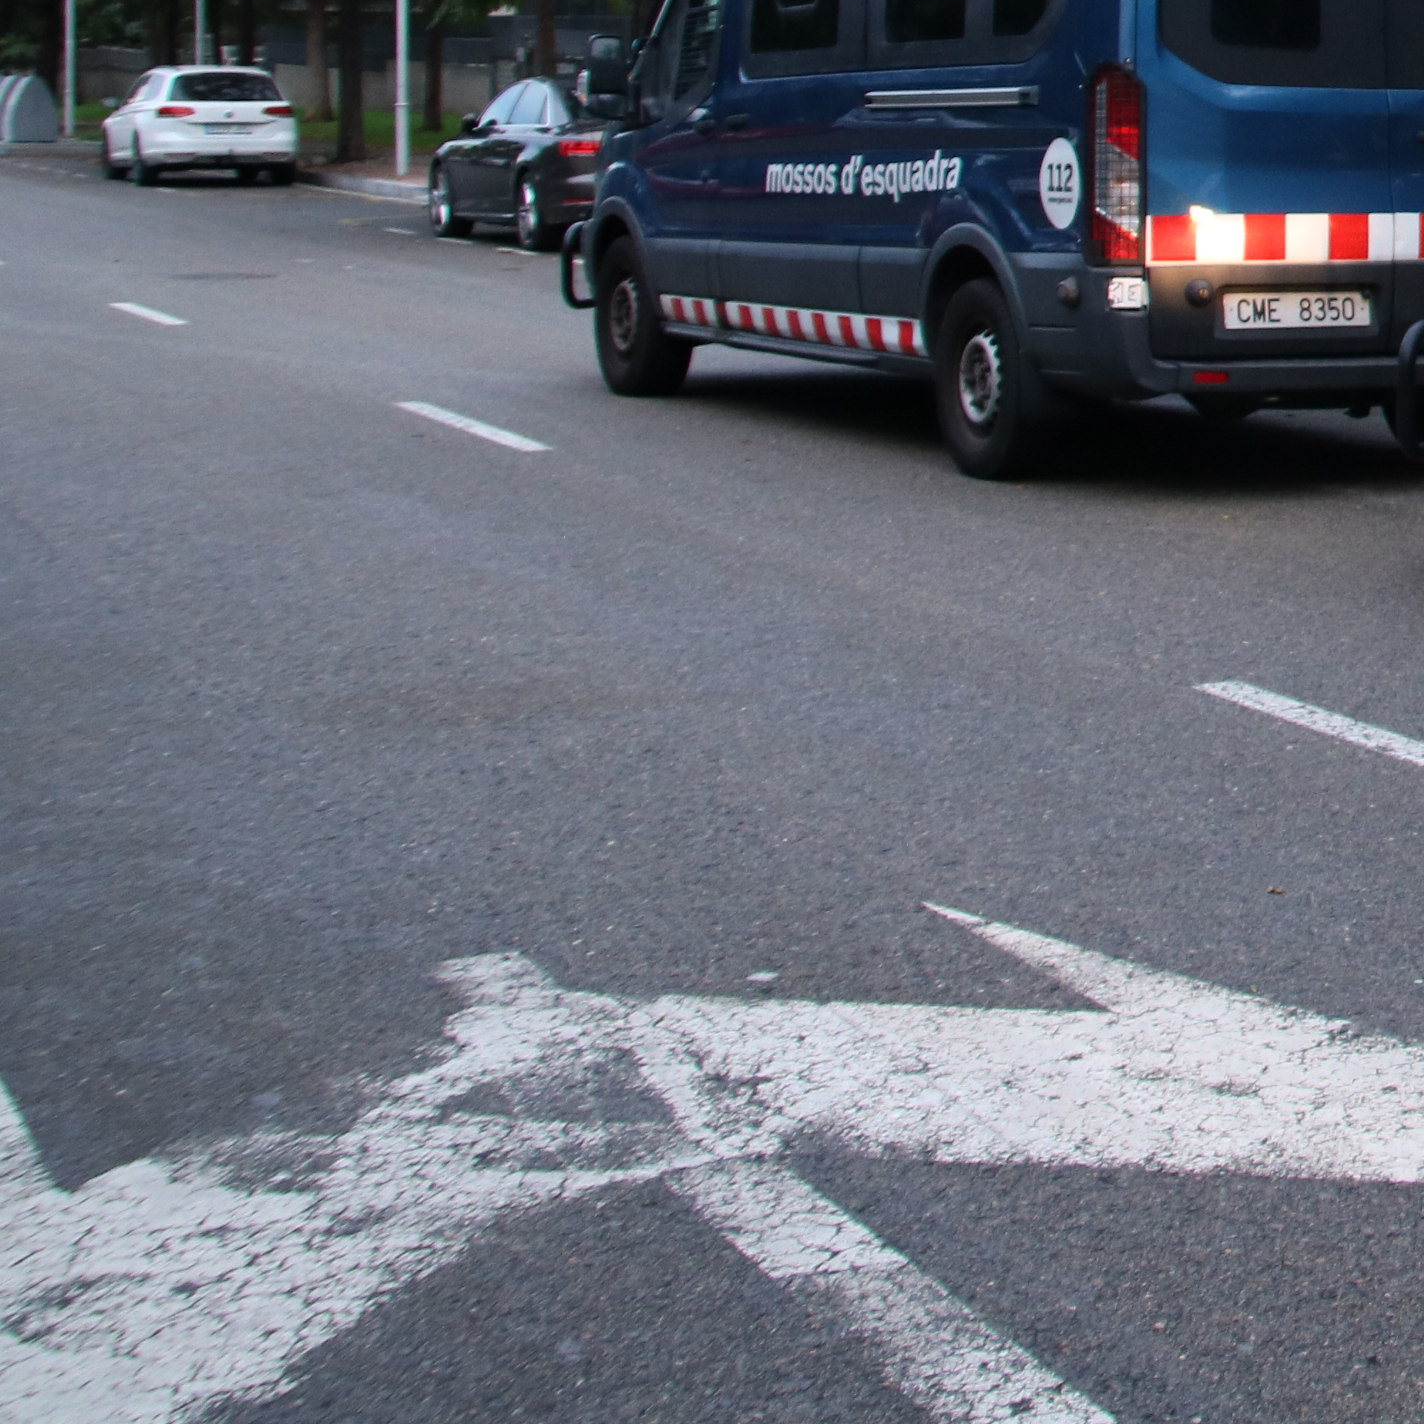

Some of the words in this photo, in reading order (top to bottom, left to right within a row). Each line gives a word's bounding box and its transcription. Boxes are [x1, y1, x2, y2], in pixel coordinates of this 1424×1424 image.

[766, 161, 837, 195] mossos
[840, 149, 962, 203] d'esquadra
[1047, 163, 1073, 192] 112
[1237, 298, 1281, 323] CME
[1299, 297, 1355, 321] 8350
